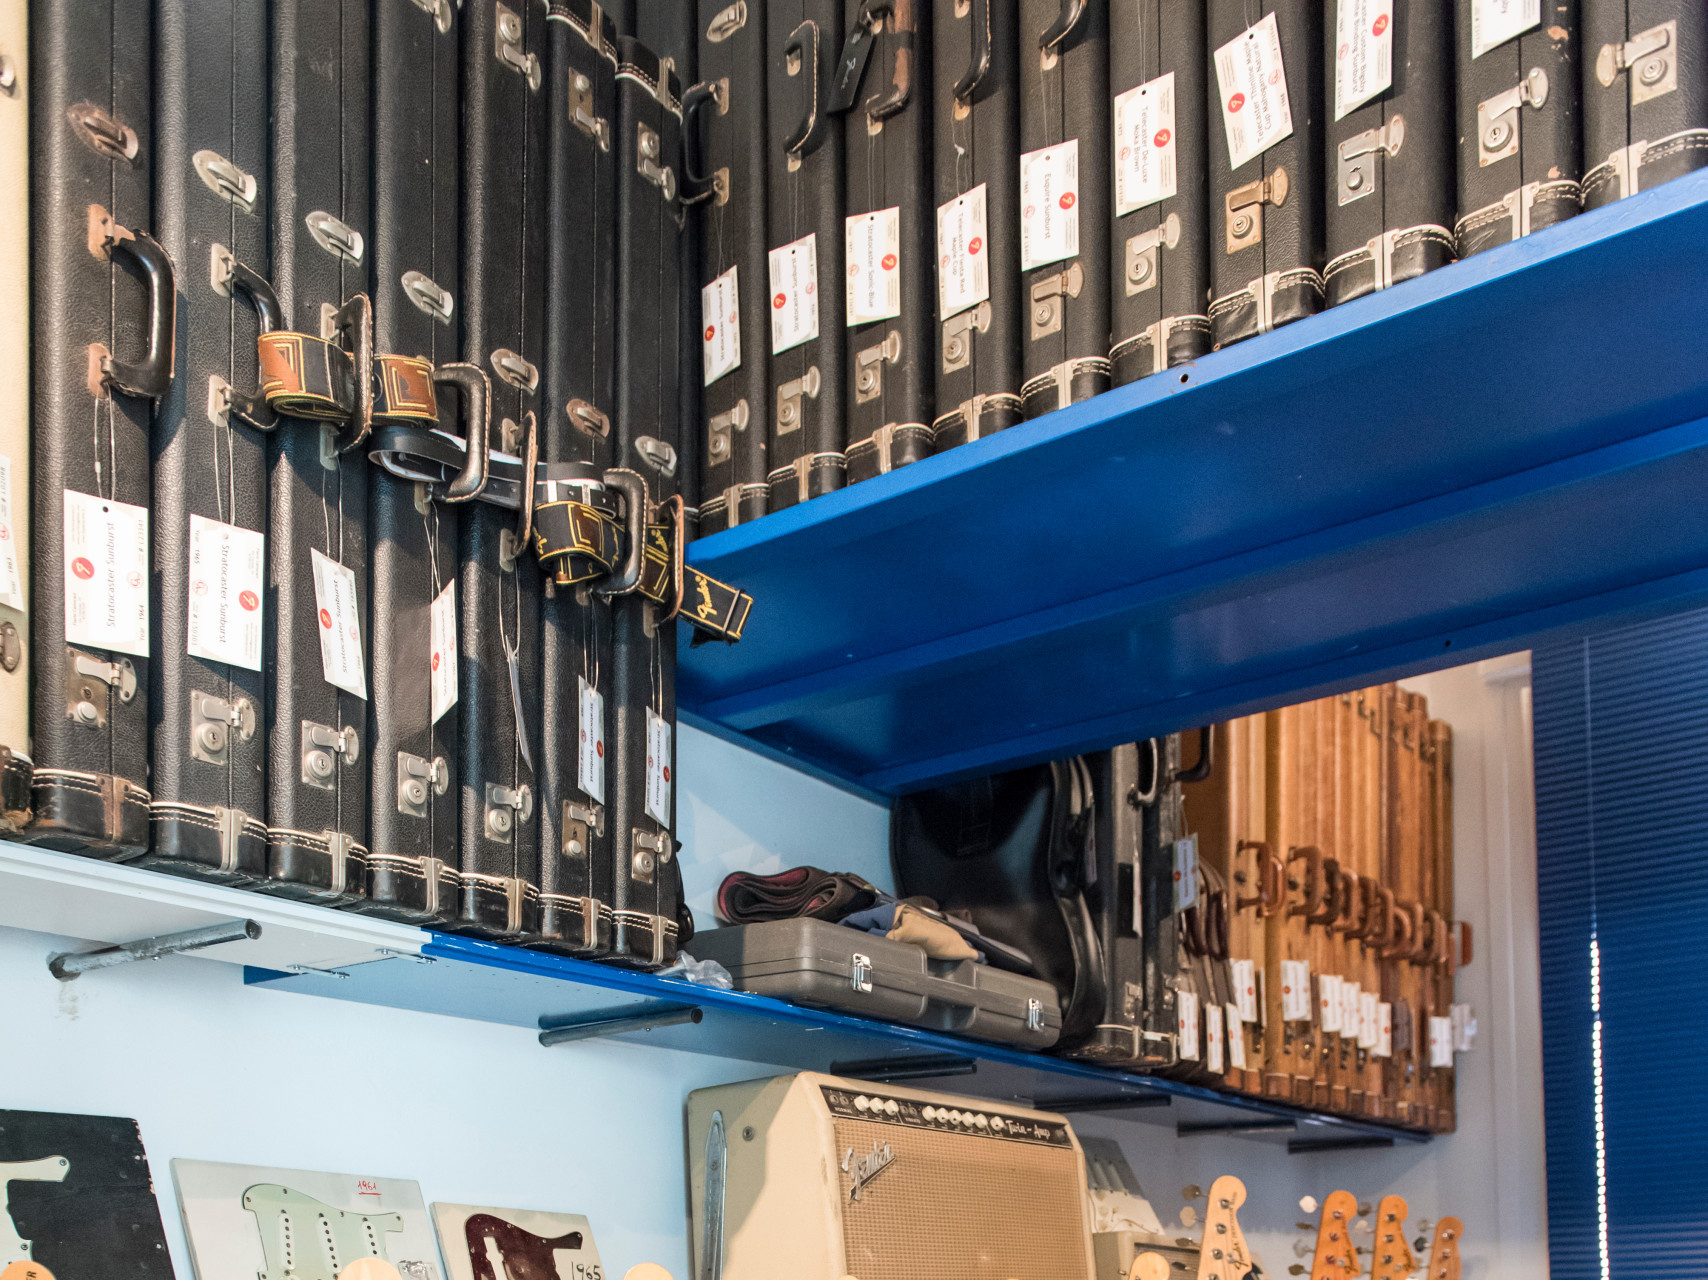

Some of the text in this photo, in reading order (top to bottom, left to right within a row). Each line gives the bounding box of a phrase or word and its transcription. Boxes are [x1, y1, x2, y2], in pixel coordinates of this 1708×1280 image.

[1352, 18, 1361, 54] Binding
[1360, 29, 1368, 63] Custom
[1243, 41, 1264, 144] Telecaster Thinline Maple
[1252, 42, 1272, 131] Cup Mahogany Natural
[1352, 54, 1360, 95] Sunburst
[1359, 64, 1367, 93] Bigsby
[1043, 173, 1052, 240] Esquire Sunburst
[867, 223, 875, 268] Stratocaster
[791, 258, 799, 289] Sunburst
[105, 522, 116, 628] Stratocaster Sunburst
[193, 549, 202, 565] 1965
[219, 545, 231, 643] Stratocaster Sunburst
[332, 580, 348, 674] Stratocaster Sunburst
[357, 1180, 377, 1192] 1961
[841, 1140, 897, 1201] Fender
